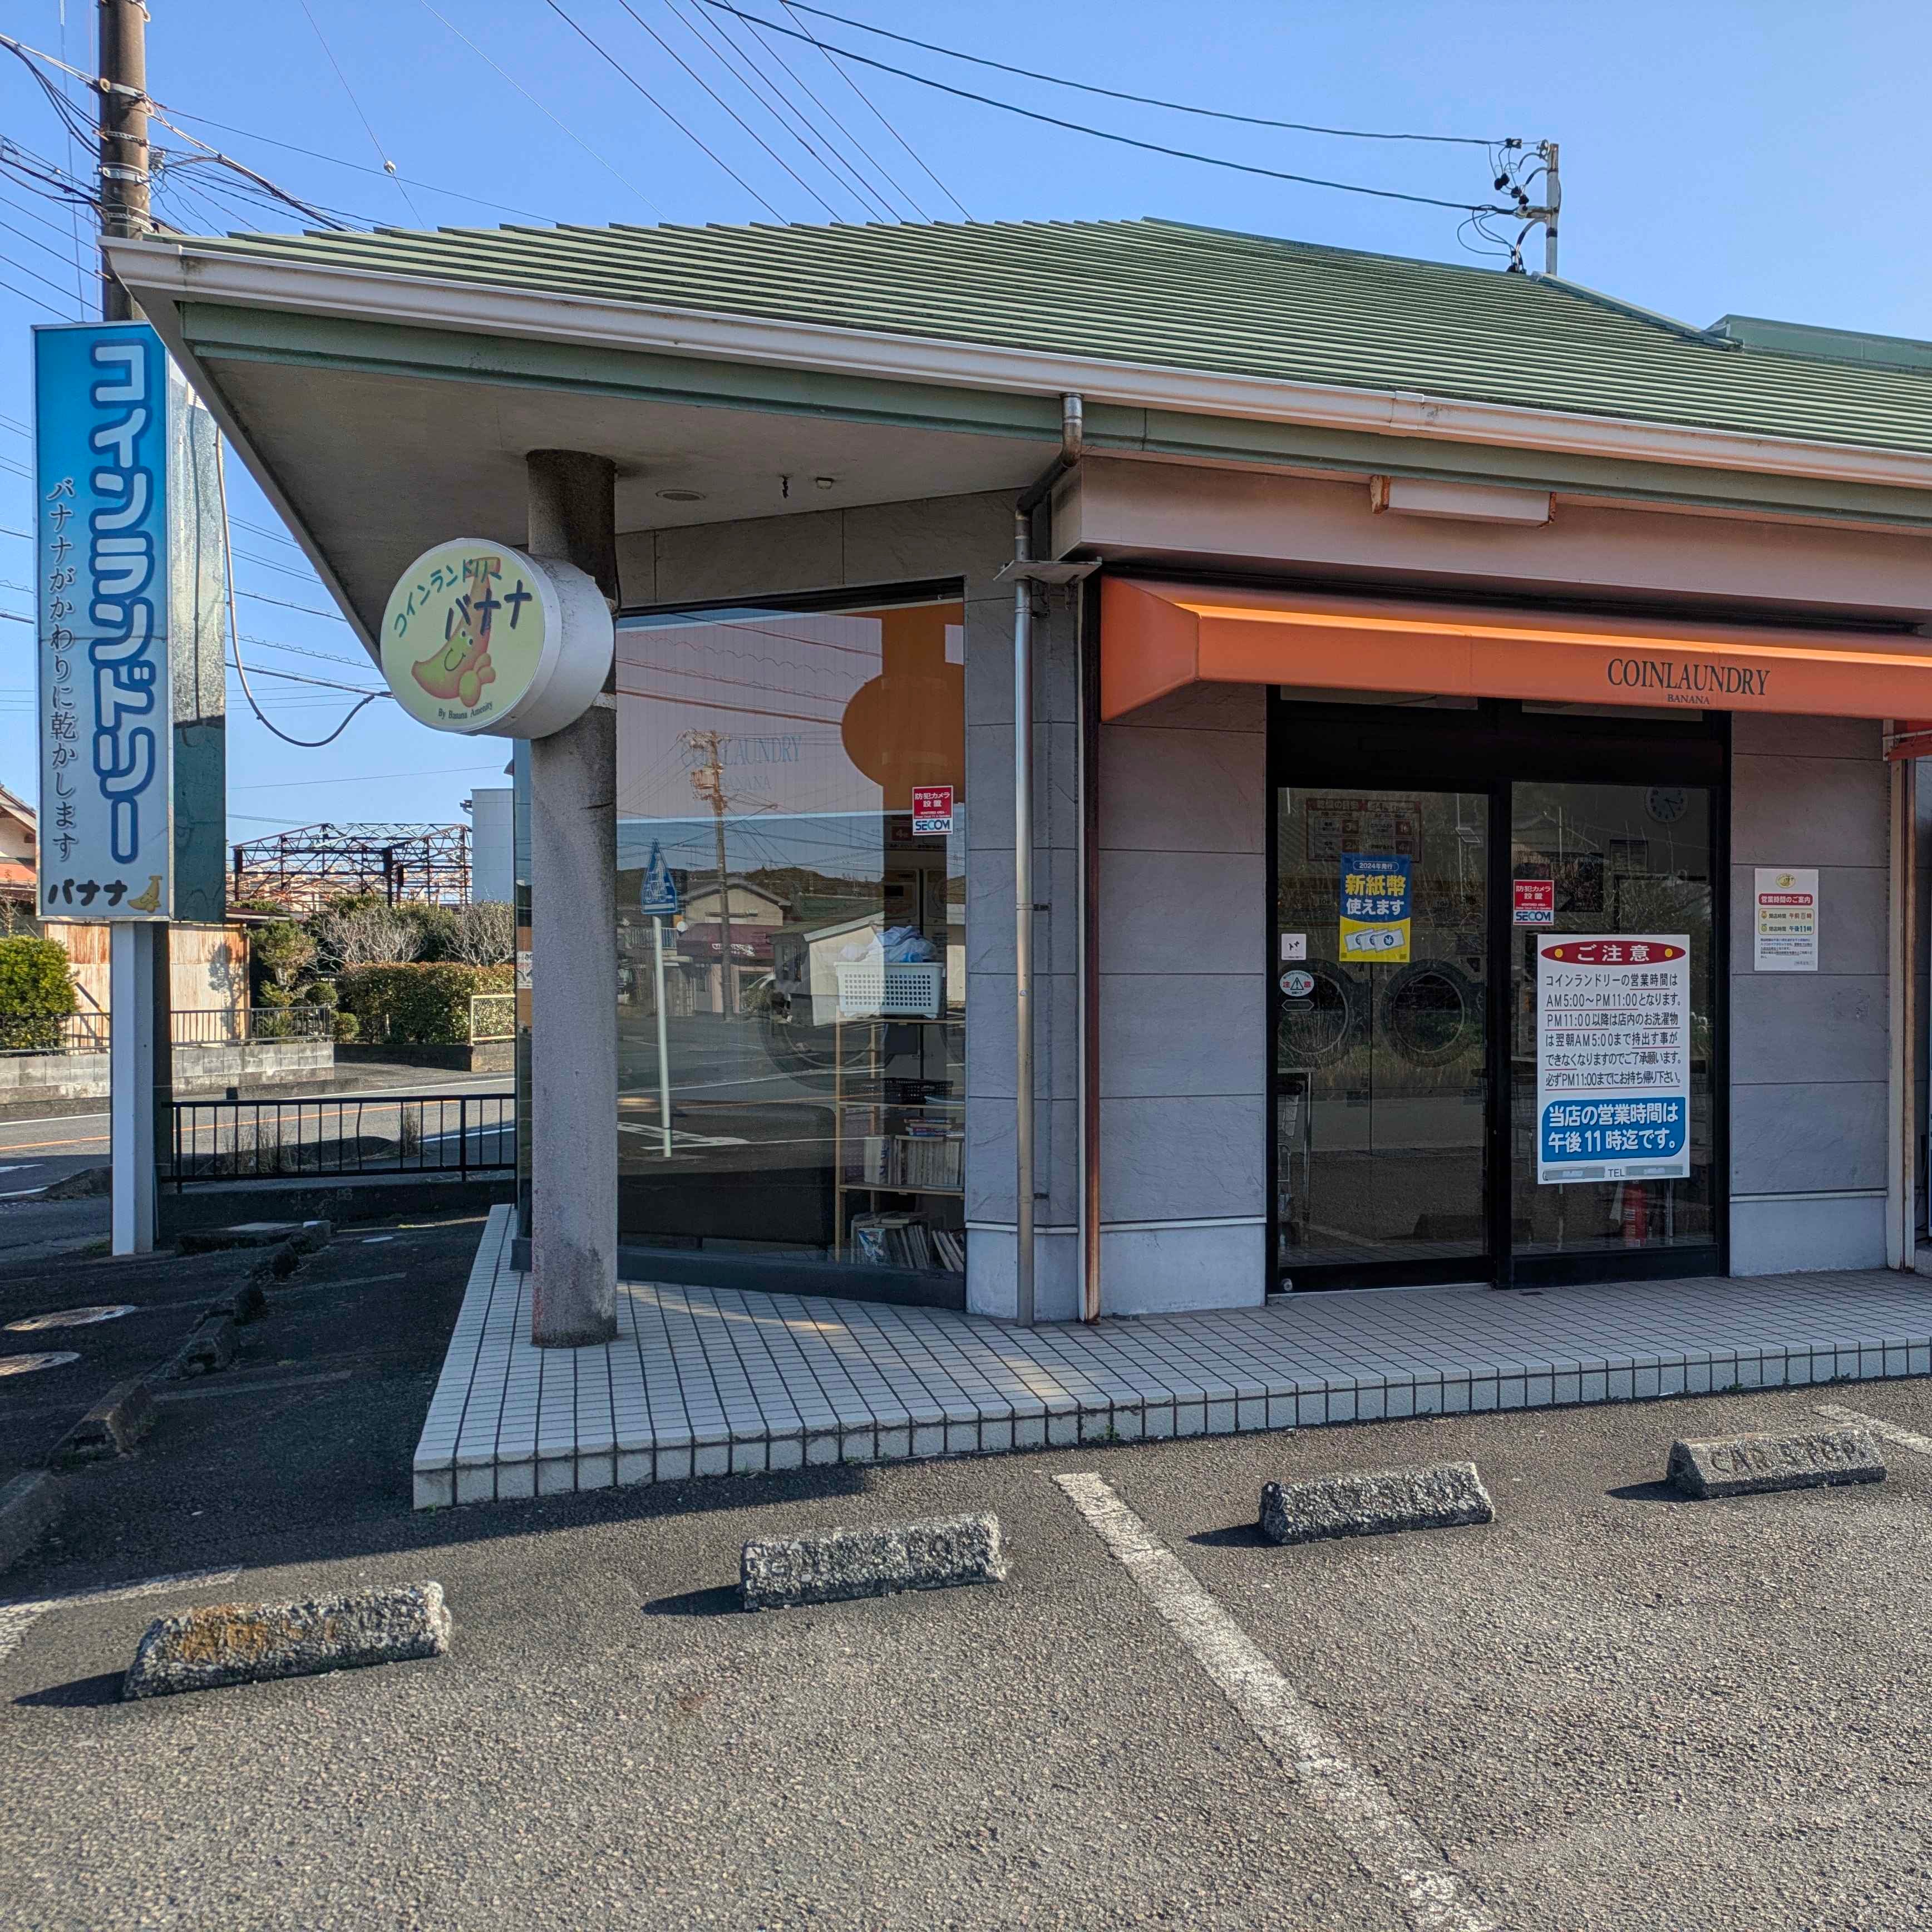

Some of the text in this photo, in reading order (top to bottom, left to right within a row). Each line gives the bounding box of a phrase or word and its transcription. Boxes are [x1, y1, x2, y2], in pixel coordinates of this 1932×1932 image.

[89, 338, 155, 865] コインランドリー
[394, 558, 502, 638] コインランドリー
[445, 579, 533, 641] バナナ
[46, 479, 77, 862] バナナがかわりに乾かします
[1608, 659, 1770, 695] COINLAUNDRY
[1667, 694, 1710, 704] BANANA
[438, 702, 492, 719] By Banana Amenity
[915, 819, 950, 830] SECOM
[1345, 873, 1406, 896] 新紙幣
[48, 879, 128, 908] バナナ
[1346, 899, 1404, 915] 使えます
[1516, 911, 1551, 921] SECOM
[1577, 944, 1650, 962] ご注意
[1546, 973, 1678, 987] コインランドリーの営業時間は
[1547, 1012, 1678, 1027] PM11:00以降は店内のお洗濯物
[1546, 1032, 1678, 1047] は翌朝AM5:00まで持出す事が
[1545, 1051, 1680, 1066] できなくなりますのでご了承願います。
[1546, 1071, 1680, 1087] 必ずPM11:00までにお持ち帰り下さい。
[1549, 1103, 1678, 1127] 当店の営業時間は
[1548, 1129, 1675, 1154] 午後11時迄です。
[1608, 1168, 1625, 1177] TEL
